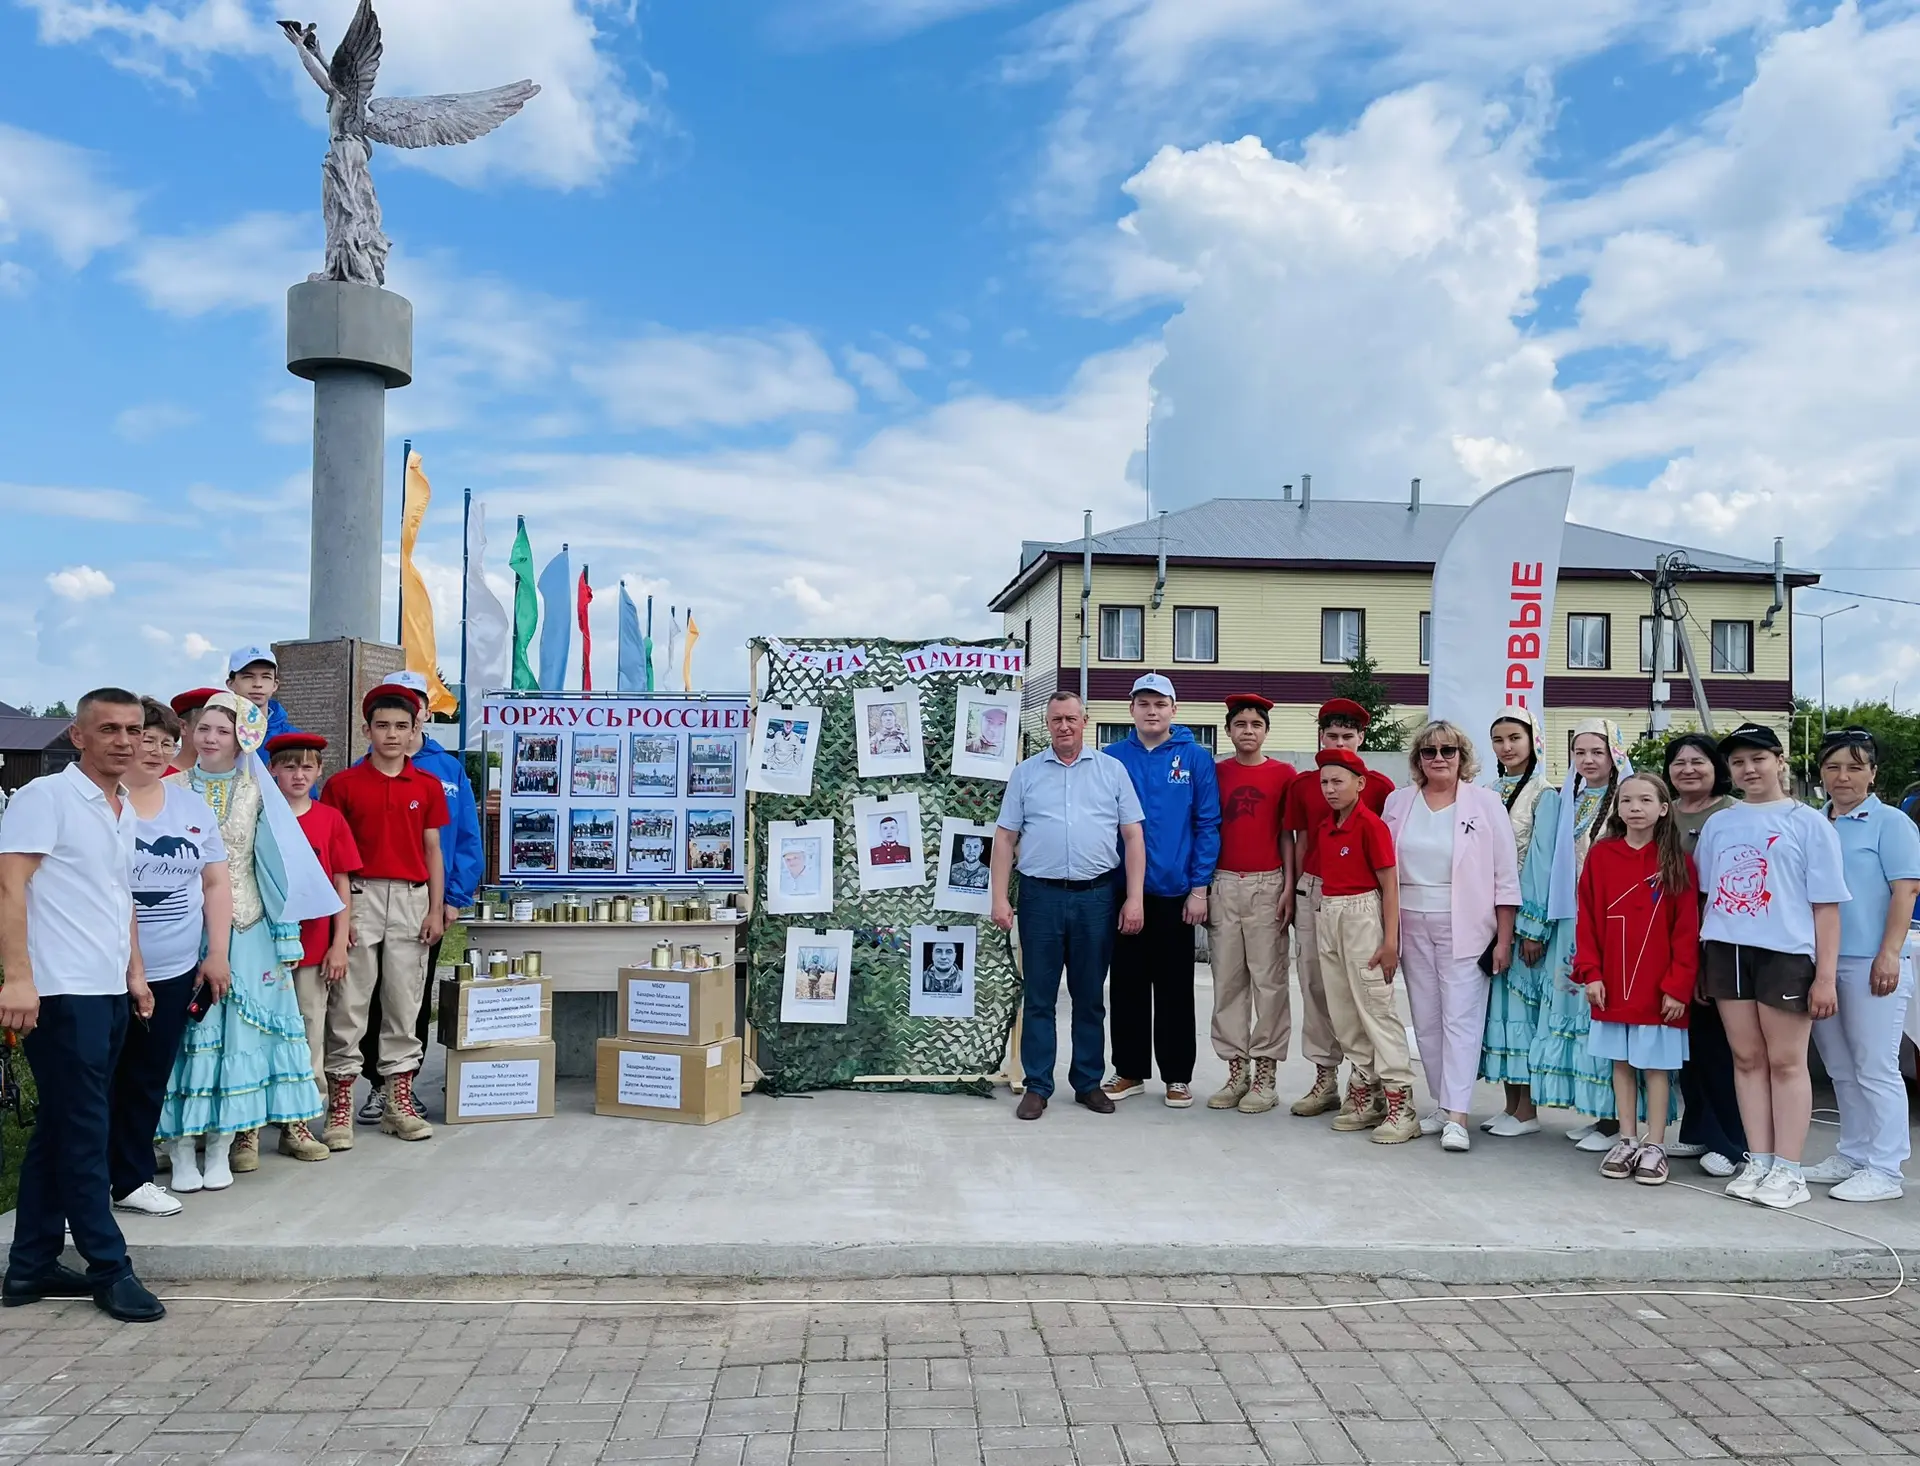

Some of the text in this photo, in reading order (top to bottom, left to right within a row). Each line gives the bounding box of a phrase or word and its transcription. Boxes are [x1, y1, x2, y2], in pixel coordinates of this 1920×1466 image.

[902, 651, 1021, 673] ПАМЯТИ
[482, 705, 622, 727] ГОРЖУСЬ
[132, 862, 150, 881] of
